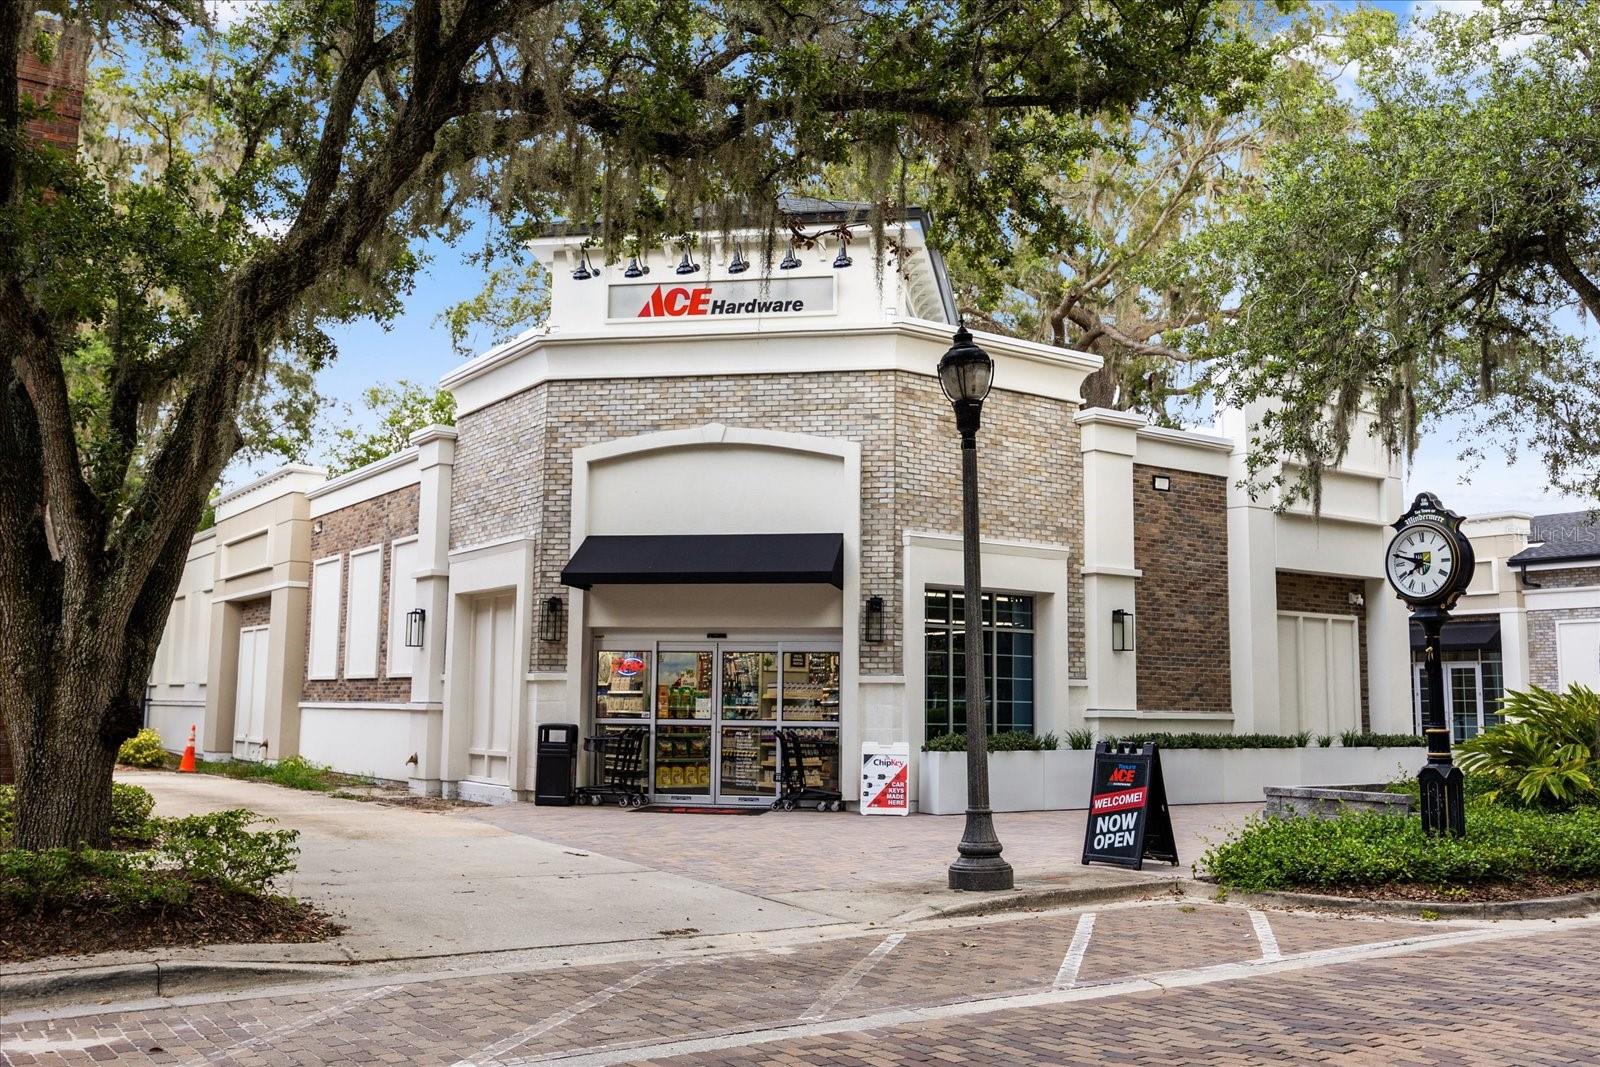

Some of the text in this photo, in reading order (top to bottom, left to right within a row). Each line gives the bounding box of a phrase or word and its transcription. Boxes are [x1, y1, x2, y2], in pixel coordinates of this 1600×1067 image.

[638, 283, 804, 317] ACE Hardware
[1109, 768, 1136, 783] ACE
[1094, 792, 1142, 809] WELCOME!
[1096, 812, 1138, 834] NOW
[1093, 831, 1135, 849] OPEN
